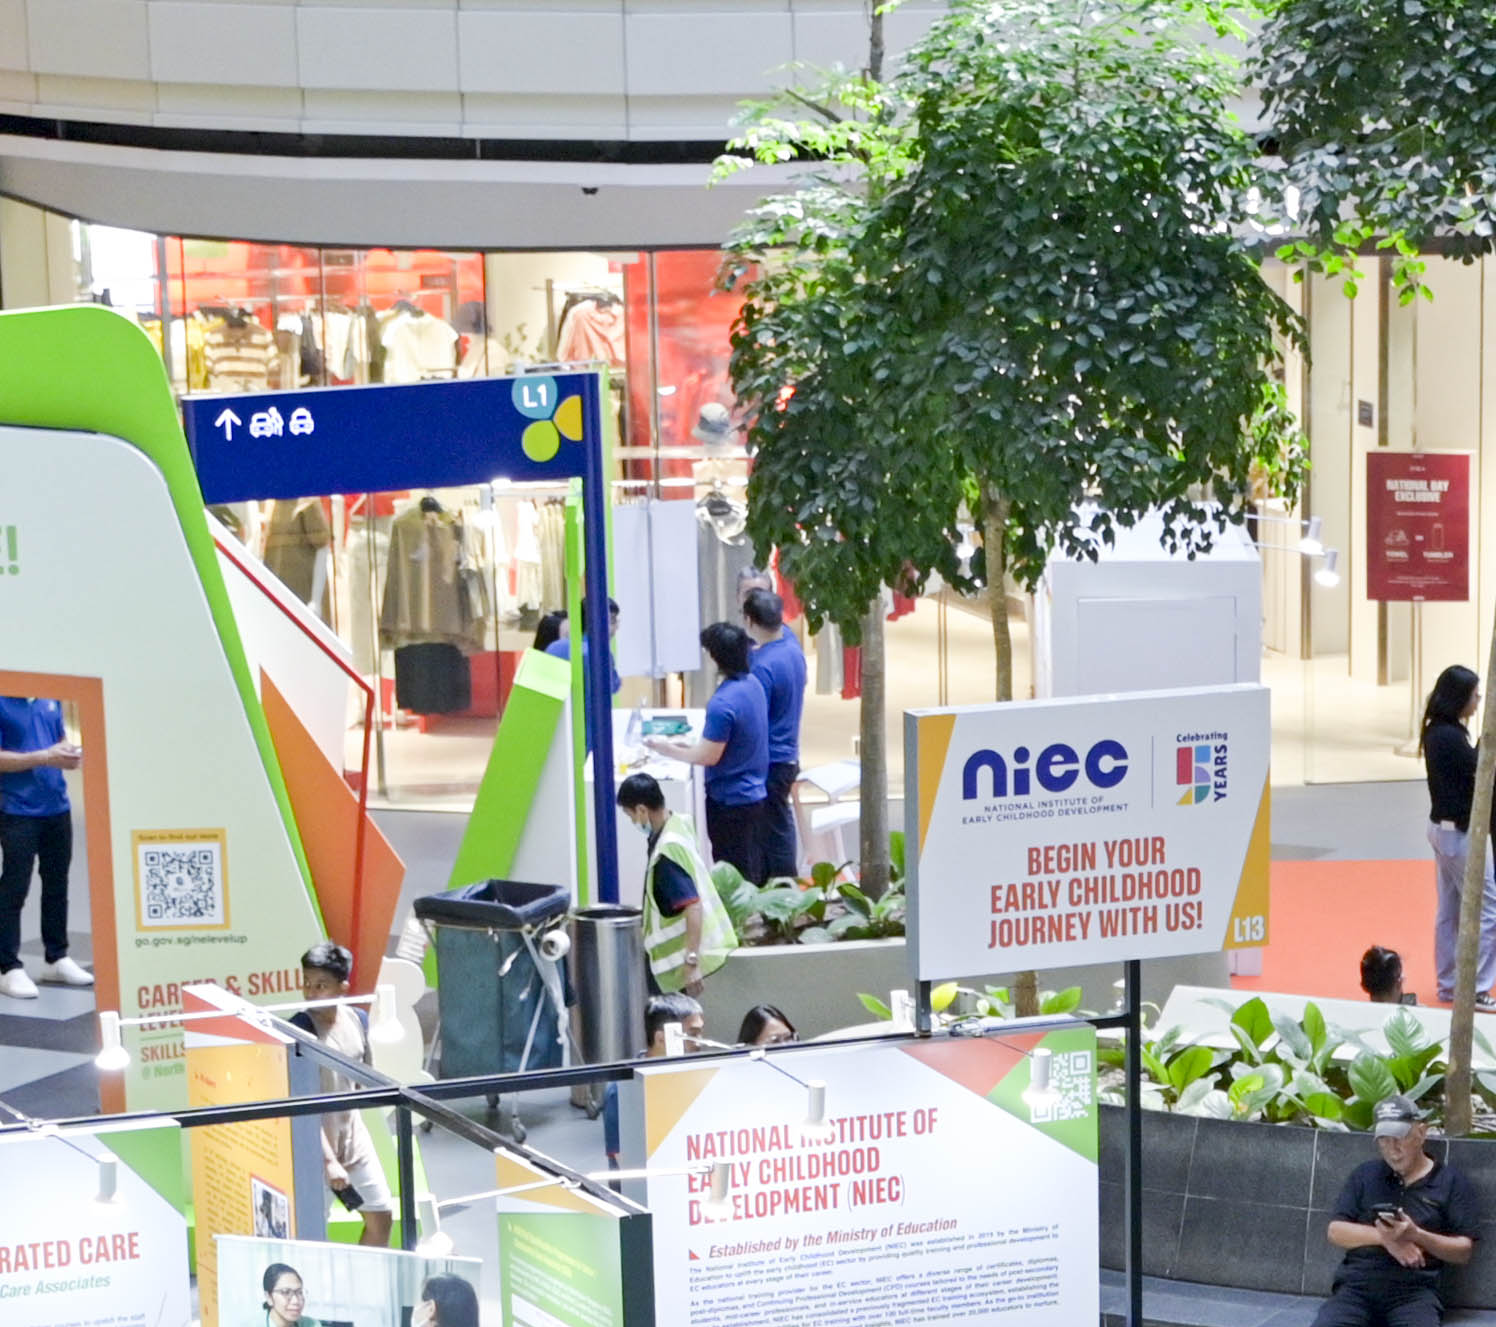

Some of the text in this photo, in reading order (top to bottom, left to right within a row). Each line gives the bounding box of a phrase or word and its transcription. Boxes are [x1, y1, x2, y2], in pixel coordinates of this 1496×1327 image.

[521, 383, 548, 408] L1
[1176, 731, 1228, 742] Celebrating
[962, 739, 1129, 801] niec
[1214, 744, 1227, 802] YEARS
[963, 803, 1129, 824] EARLY CHILDHOOD DEVELOPMENT
[984, 796, 1104, 813] NATIONAL INSTITUTE OF
[1027, 835, 1166, 877] BEGIN YOUR
[990, 866, 1202, 915] EARLY CHILDHOOD
[987, 900, 1203, 950] JOURNEY WITH US!
[1234, 916, 1264, 942] L13
[135, 935, 247, 947] go.gov.sg/nelevelup
[78, 1231, 141, 1265] CARE
